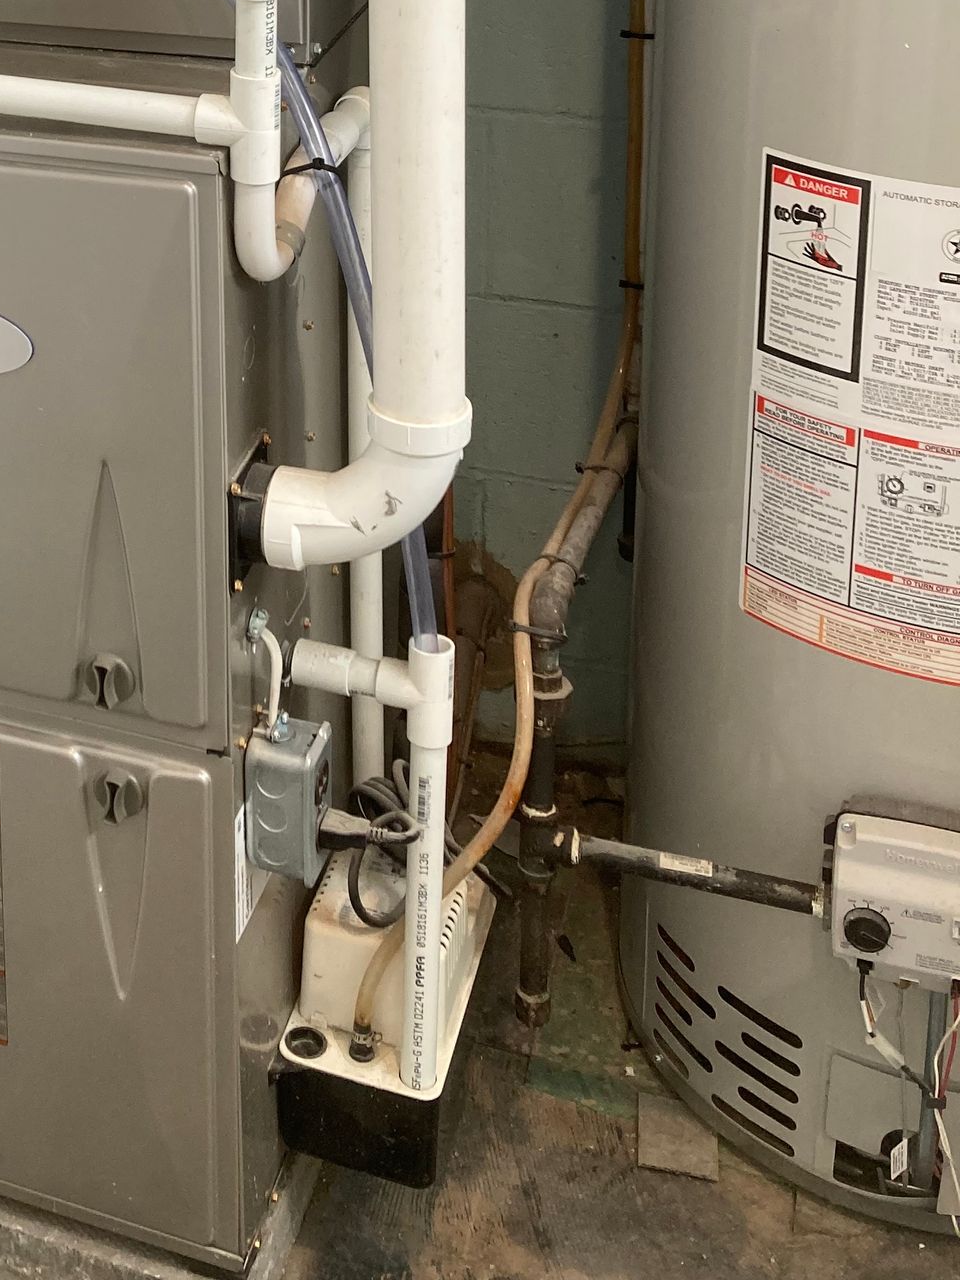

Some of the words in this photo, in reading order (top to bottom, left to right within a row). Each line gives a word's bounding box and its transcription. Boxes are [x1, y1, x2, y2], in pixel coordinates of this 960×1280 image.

[799, 177, 849, 200] DANGER
[882, 190, 933, 205] AUTOMATIC
[811, 231, 829, 242] HOT
[764, 407, 781, 419] READ
[781, 414, 806, 429] BEFORE
[807, 424, 845, 441] OPERATING
[775, 406, 788, 416] FOR
[789, 412, 807, 422] YOUR
[807, 418, 833, 431] SAFETY
[902, 577, 912, 586] TO
[914, 580, 934, 591] TURN
[935, 585, 950, 594] OFF
[900, 627, 936, 640] CONTROL
[414, 956, 426, 988] PPFA
[412, 1022, 424, 1049] ASTM
